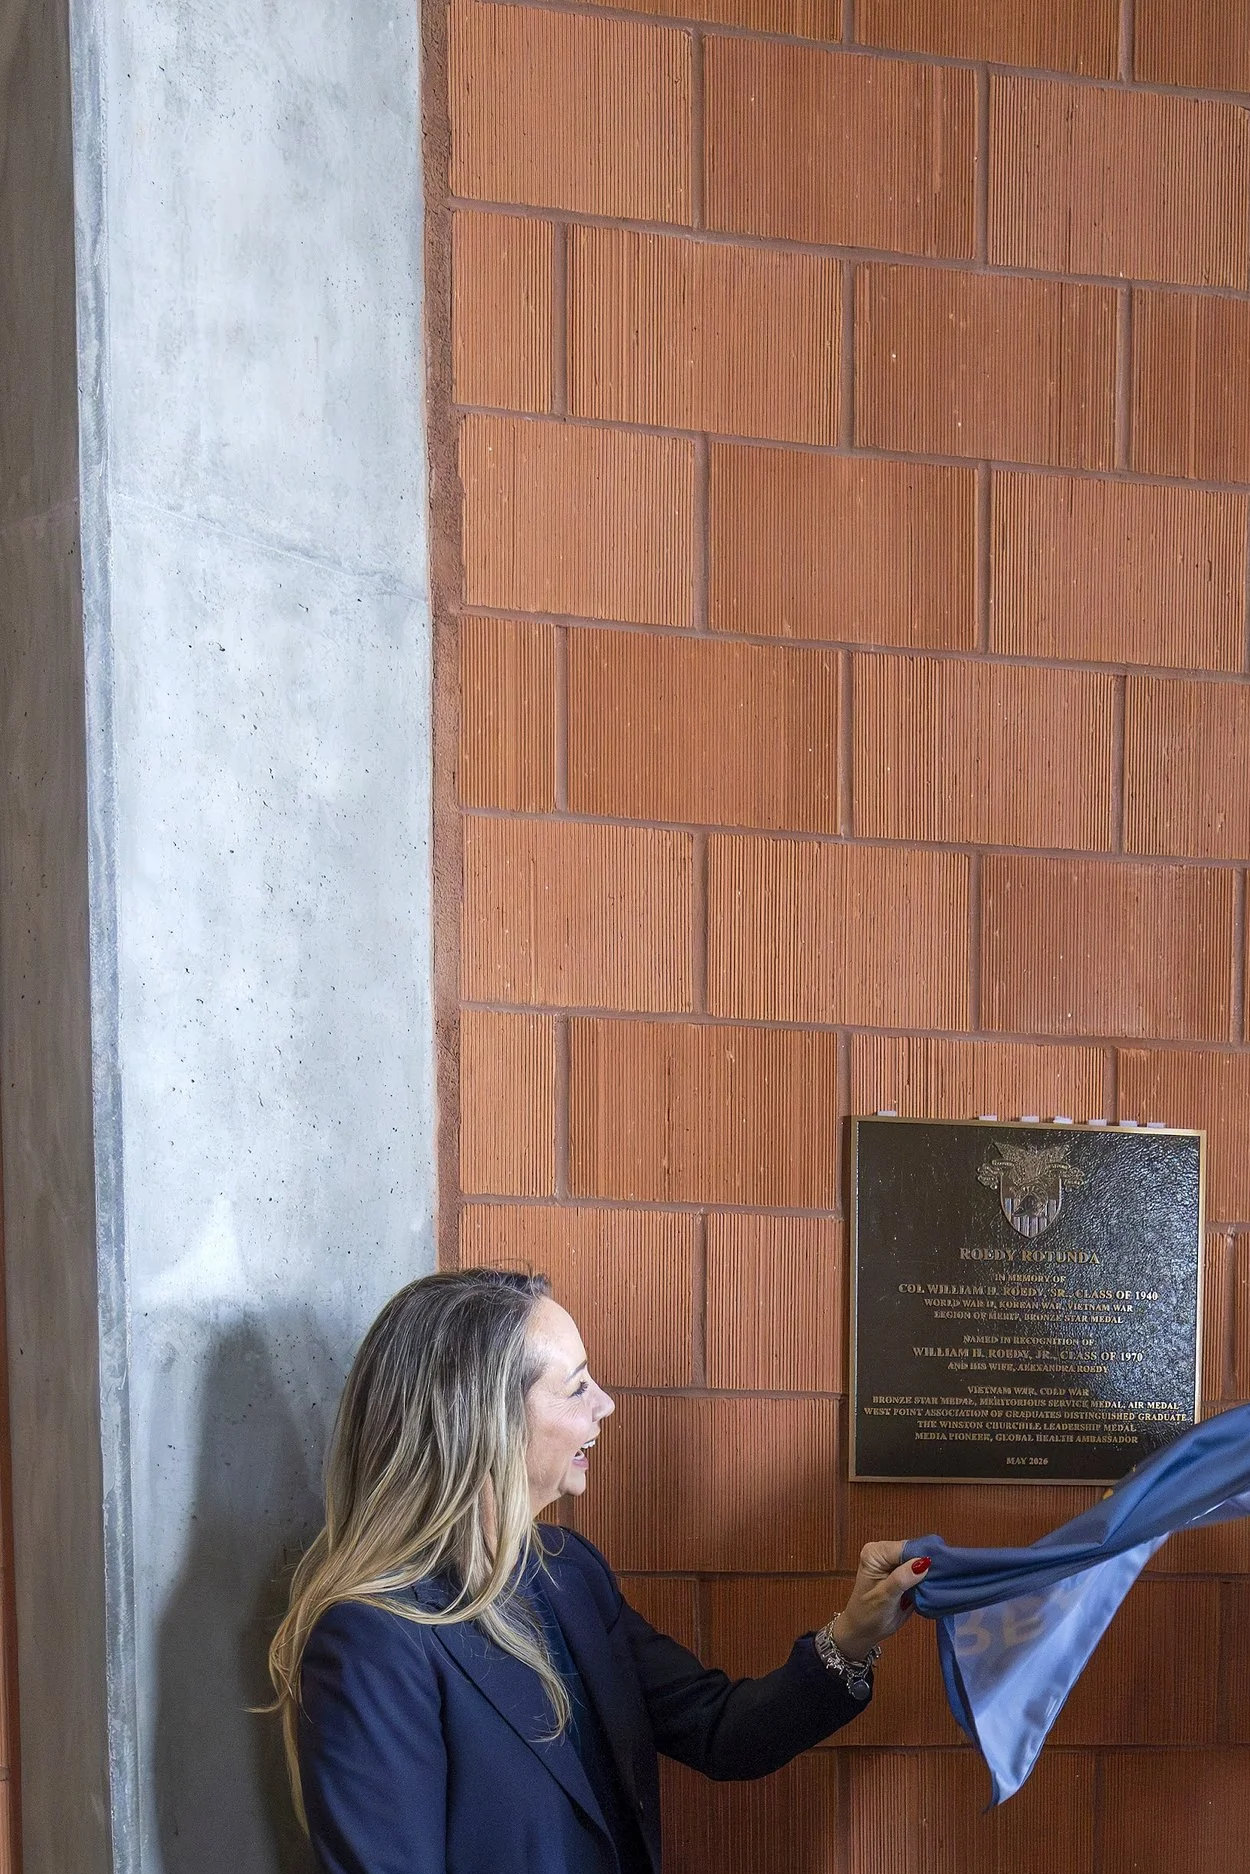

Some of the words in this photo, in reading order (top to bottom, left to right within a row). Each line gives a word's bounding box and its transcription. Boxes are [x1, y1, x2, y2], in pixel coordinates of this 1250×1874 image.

[960, 1248, 1015, 1261] ROEDY
[1022, 1250, 1100, 1264] ROTUNDA
[1008, 1274, 1050, 1282] MEMORY
[1053, 1275, 1066, 1283] OF
[927, 1284, 983, 1295] WILLIAM
[1004, 1286, 1046, 1298] ROEDY,
[1075, 1289, 1112, 1299] CLASS
[1116, 1291, 1132, 1300] OF
[1136, 1291, 1158, 1301] 1940
[924, 1299, 960, 1307] WORLD
[963, 1299, 984, 1307] WAR
[1000, 1301, 1038, 1309] KOREAN
[1068, 1302, 1109, 1311] VIETNAM
[934, 1311, 971, 1319] LEGION
[973, 1312, 987, 1320] OF
[988, 1312, 1021, 1321] MERIT,
[1024, 1313, 1061, 1321] BRONZE
[962, 1335, 998, 1344] NAMED
[1000, 1336, 1011, 1344] IN
[1013, 1337, 1078, 1346] RECOGNITION
[1082, 1338, 1095, 1346] OF
[912, 1347, 969, 1357] WILLIAM
[972, 1348, 984, 1358] H.
[988, 1349, 1032, 1359] ROEDY,
[1060, 1350, 1097, 1360] CLASS
[1101, 1351, 1116, 1361] OF
[1121, 1352, 1143, 1362] 1970
[947, 1362, 968, 1370] AND
[970, 1362, 986, 1370] HIS
[988, 1363, 1015, 1371] WIFE,
[1018, 1363, 1074, 1372] ALEXANDRA
[1077, 1365, 1108, 1373] ROEDY
[967, 1386, 1011, 1394] VIETNAM
[1014, 1387, 1037, 1395] WAR,
[1040, 1387, 1065, 1395] COLD
[1068, 1388, 1089, 1396] WAR
[872, 1396, 912, 1404] BRONZE
[914, 1396, 938, 1404] STAR
[941, 1397, 977, 1406] MEDAL,
[979, 1398, 1047, 1406] MERITORIOUS
[1048, 1399, 1088, 1408] SERVICE
[1091, 1400, 1125, 1409] MEDAL,
[1128, 1401, 1144, 1409] AIR
[1147, 1402, 1179, 1410] MEDAL
[863, 1407, 891, 1416] WEST
[893, 1408, 923, 1416] POINT
[925, 1409, 989, 1417] ASSOCIATION
[991, 1410, 1003, 1418] OF
[1005, 1411, 1061, 1419] GRADUATES
[1064, 1412, 1135, 1421] DISTINGUISHED
[1138, 1413, 1187, 1421] GRADUATE
[917, 1420, 937, 1428] THE
[939, 1421, 983, 1429] WINSTON
[1043, 1422, 1101, 1431] LEADERSHIP
[1103, 1424, 1137, 1432] MEDAL
[914, 1432, 947, 1440] MEDIA
[949, 1432, 992, 1442] PIONEER,
[995, 1433, 1034, 1441] GLOBAL
[1036, 1434, 1074, 1442] HEALTH
[1075, 1435, 1138, 1444] AMBASSADOR
[1006, 1456, 1027, 1465] MAY
[1029, 1456, 1049, 1465] 2026
